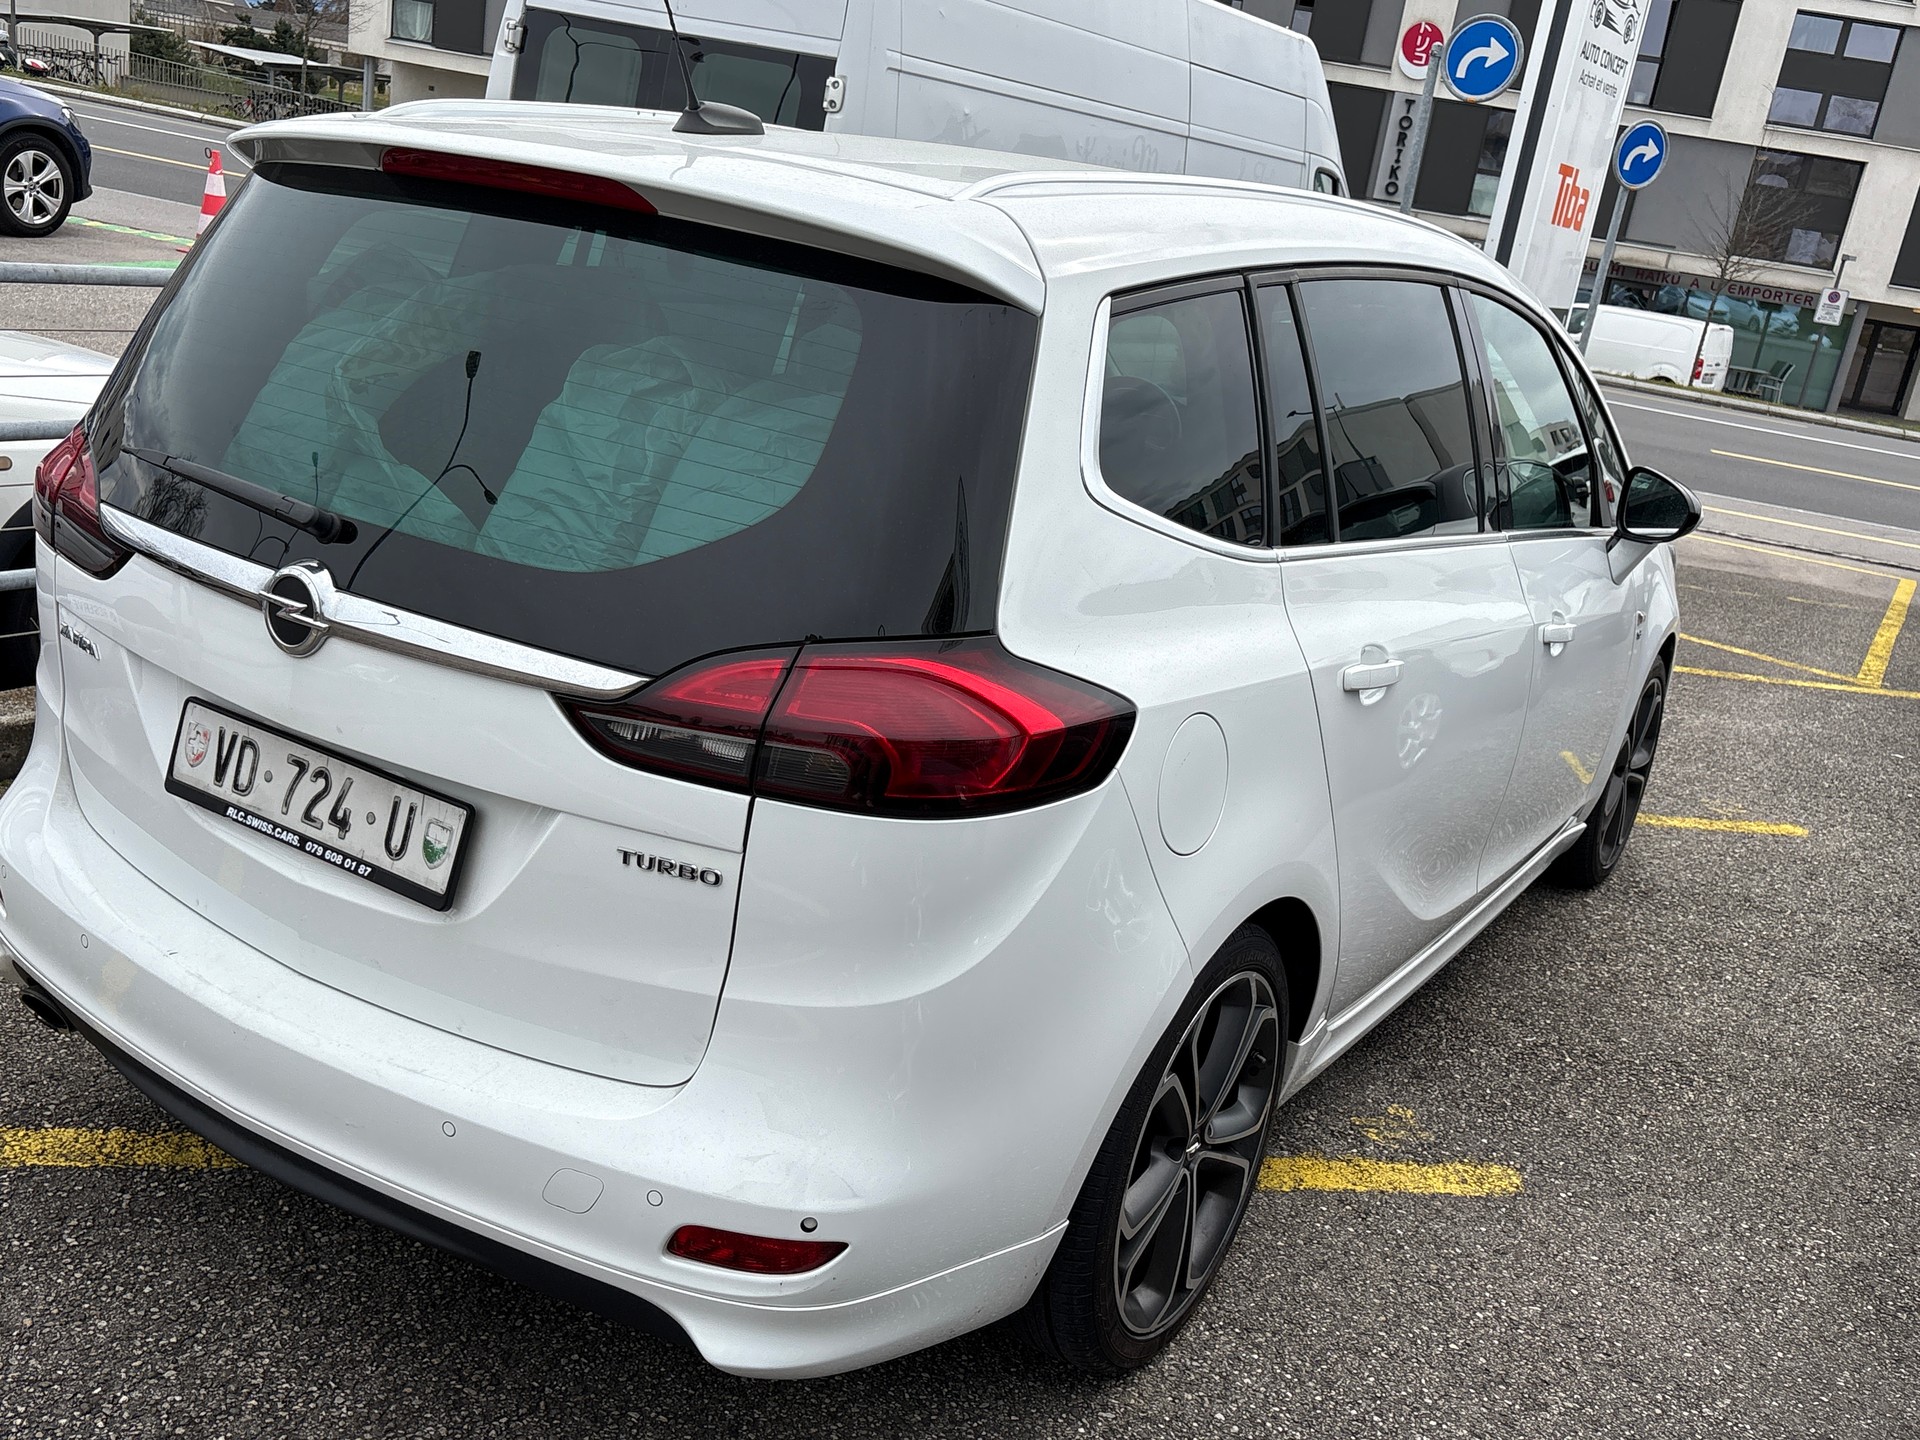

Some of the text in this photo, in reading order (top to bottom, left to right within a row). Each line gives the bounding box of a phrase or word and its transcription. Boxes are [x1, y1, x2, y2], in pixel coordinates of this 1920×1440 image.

[1413, 22, 1432, 64] トリコ
[1580, 40, 1629, 78] AUTO CONCEPT
[1579, 69, 1618, 99] Achat et vente
[1384, 99, 1416, 196] TORIKO
[1551, 163, 1590, 232] Tiba
[1583, 261, 1625, 276] SUHI
[1635, 268, 1681, 286] HAIKU
[213, 726, 417, 861] VD 724 U
[226, 807, 372, 877] RLC.SWISS.CARS. 079 608 01 87
[616, 846, 723, 887] TURBO
